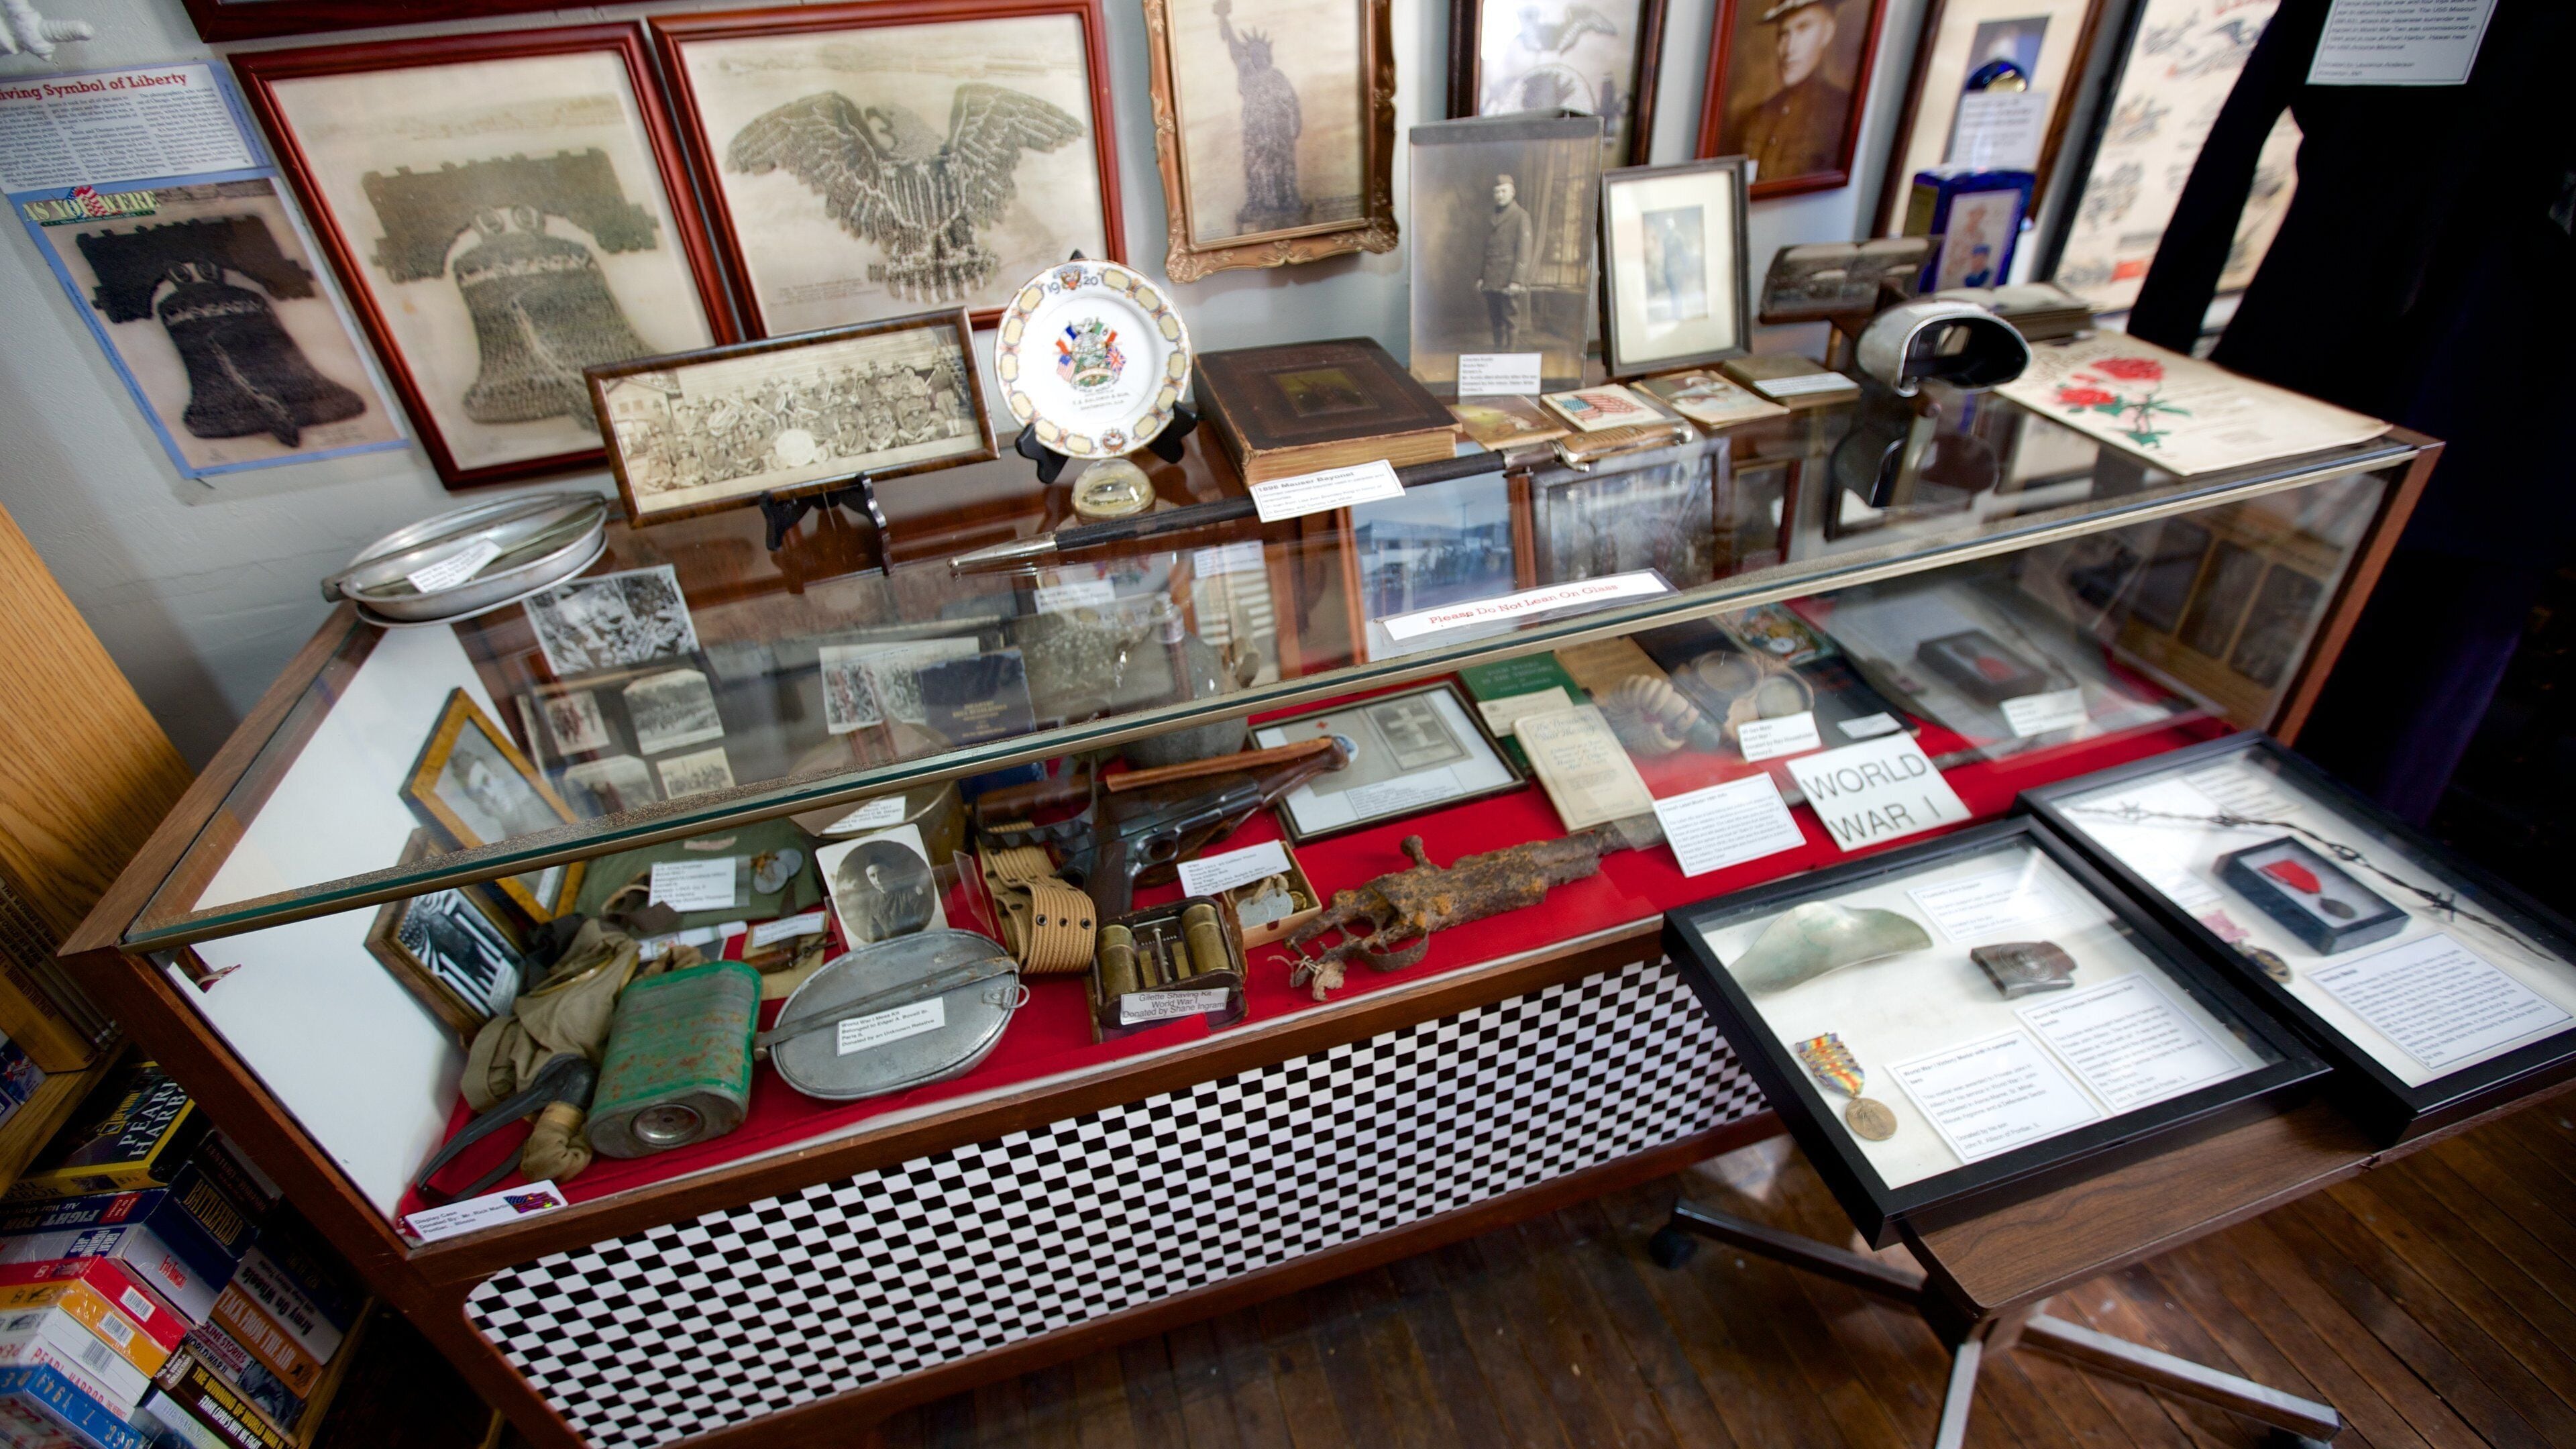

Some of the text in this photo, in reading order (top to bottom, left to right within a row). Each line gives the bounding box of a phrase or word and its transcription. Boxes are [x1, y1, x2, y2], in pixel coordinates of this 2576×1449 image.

[44, 73, 188, 97] Symbol of Liberty
[23, 201, 50, 221] AS
[97, 191, 160, 214] WERE
[1047, 276, 1098, 294] 19 20
[1281, 479, 1313, 488] Mauser
[1316, 472, 1354, 483] Bayonet
[1429, 582, 1619, 625] Please Do Not Lean On Glass
[1803, 753, 1927, 800] WORLD
[1829, 803, 1917, 843] WAR
[1923, 796, 1941, 819] I
[1151, 1000, 1174, 1008] World
[1167, 991, 1199, 1000] Shaving
[1123, 1002, 1225, 1018] Donated by Shane Ingram
[128, 1086, 189, 1158] HARB
[41, 1210, 101, 1226] FIGHT
[182, 1179, 244, 1246] BATTLEFIELD
[415, 1214, 440, 1225] Display
[419, 1220, 447, 1230] Donated
[237, 1265, 279, 1305] Wheels
[271, 1295, 292, 1317] On
[233, 1307, 273, 1345] FROM
[284, 1305, 317, 1337] Army
[218, 1337, 248, 1365] STORIES
[255, 1327, 287, 1360] THE
[205, 1352, 223, 1369] WAR
[270, 1342, 301, 1373] AIR
[190, 1366, 282, 1449] THE WINNING OF WORLD WAR
[197, 1393, 220, 1416] FRANK
[160, 1402, 193, 1432] THE WAR
[226, 1419, 244, 1438] WHY
[235, 1427, 252, 1444] WE
[243, 1433, 264, 1449] FIGHT
